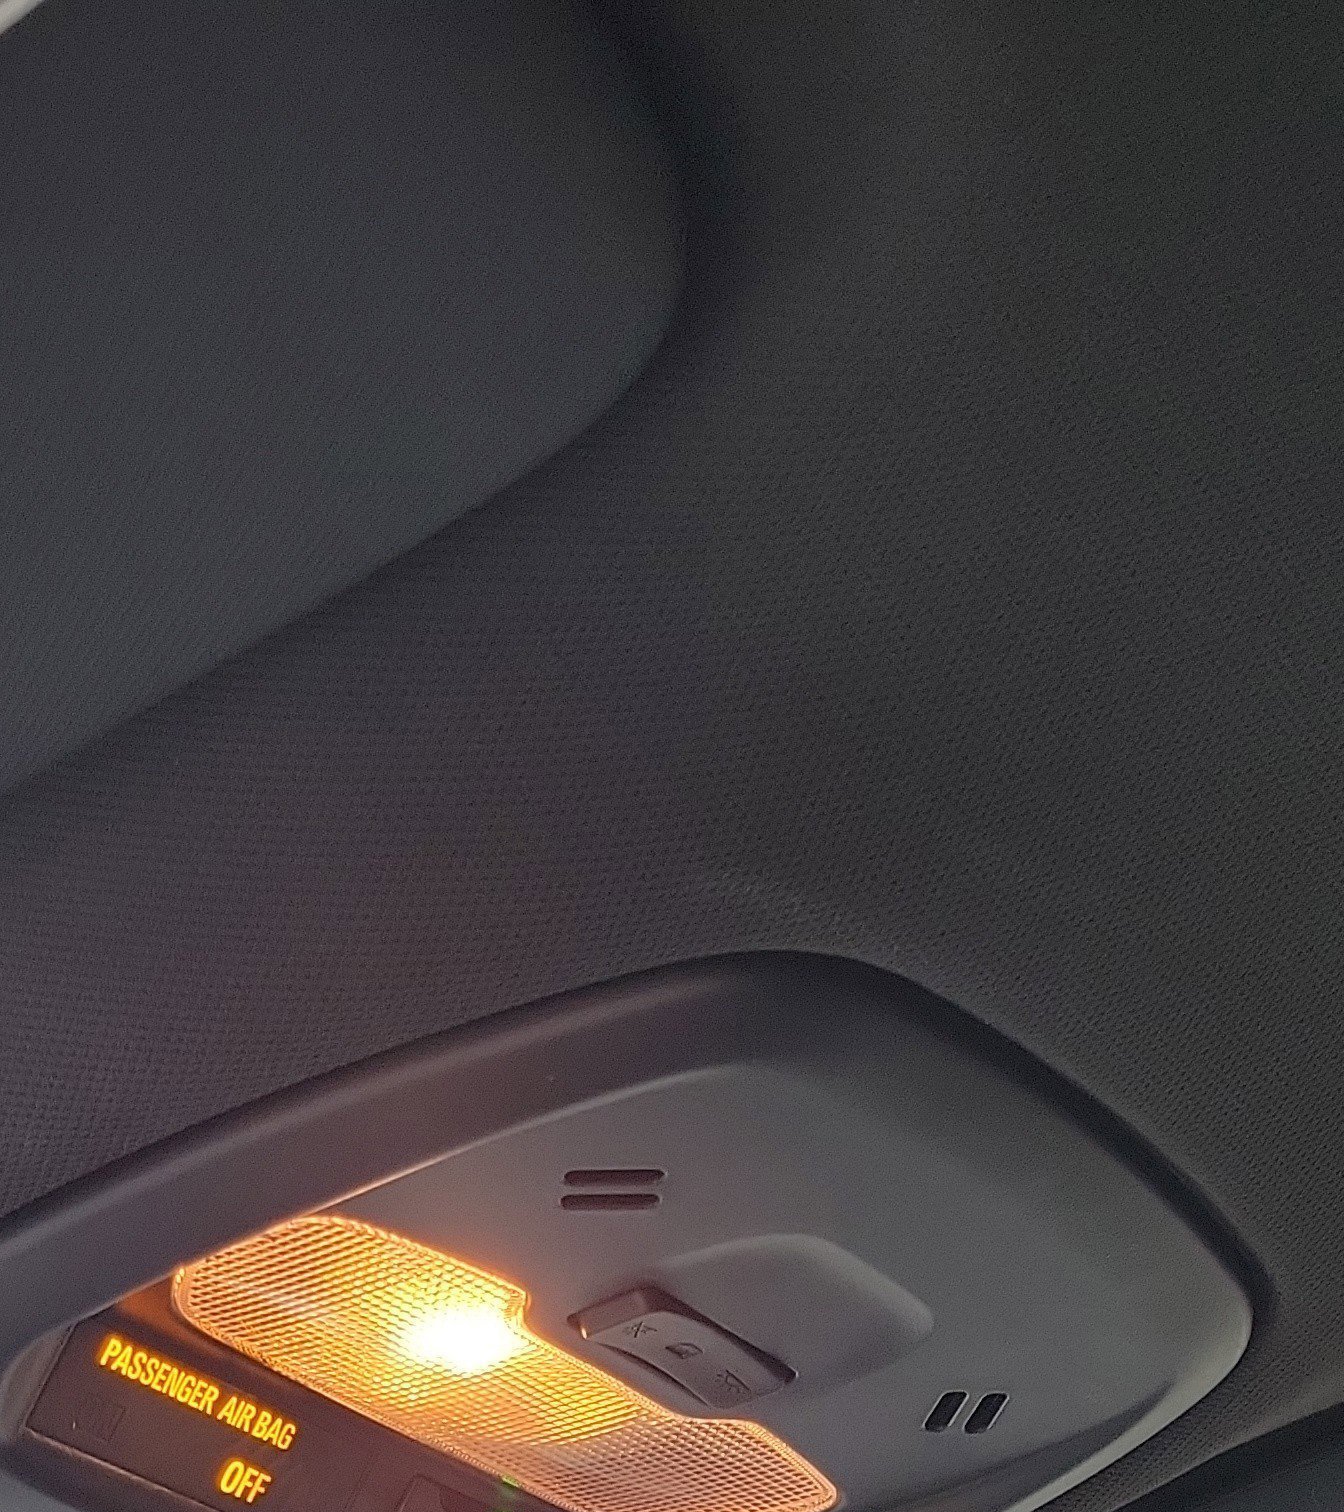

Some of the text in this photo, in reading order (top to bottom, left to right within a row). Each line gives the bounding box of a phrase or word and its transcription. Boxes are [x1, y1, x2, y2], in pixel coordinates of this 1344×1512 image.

[100, 1338, 296, 1450] PASSENGER AIR BAG
[220, 1460, 272, 1503] OFF
